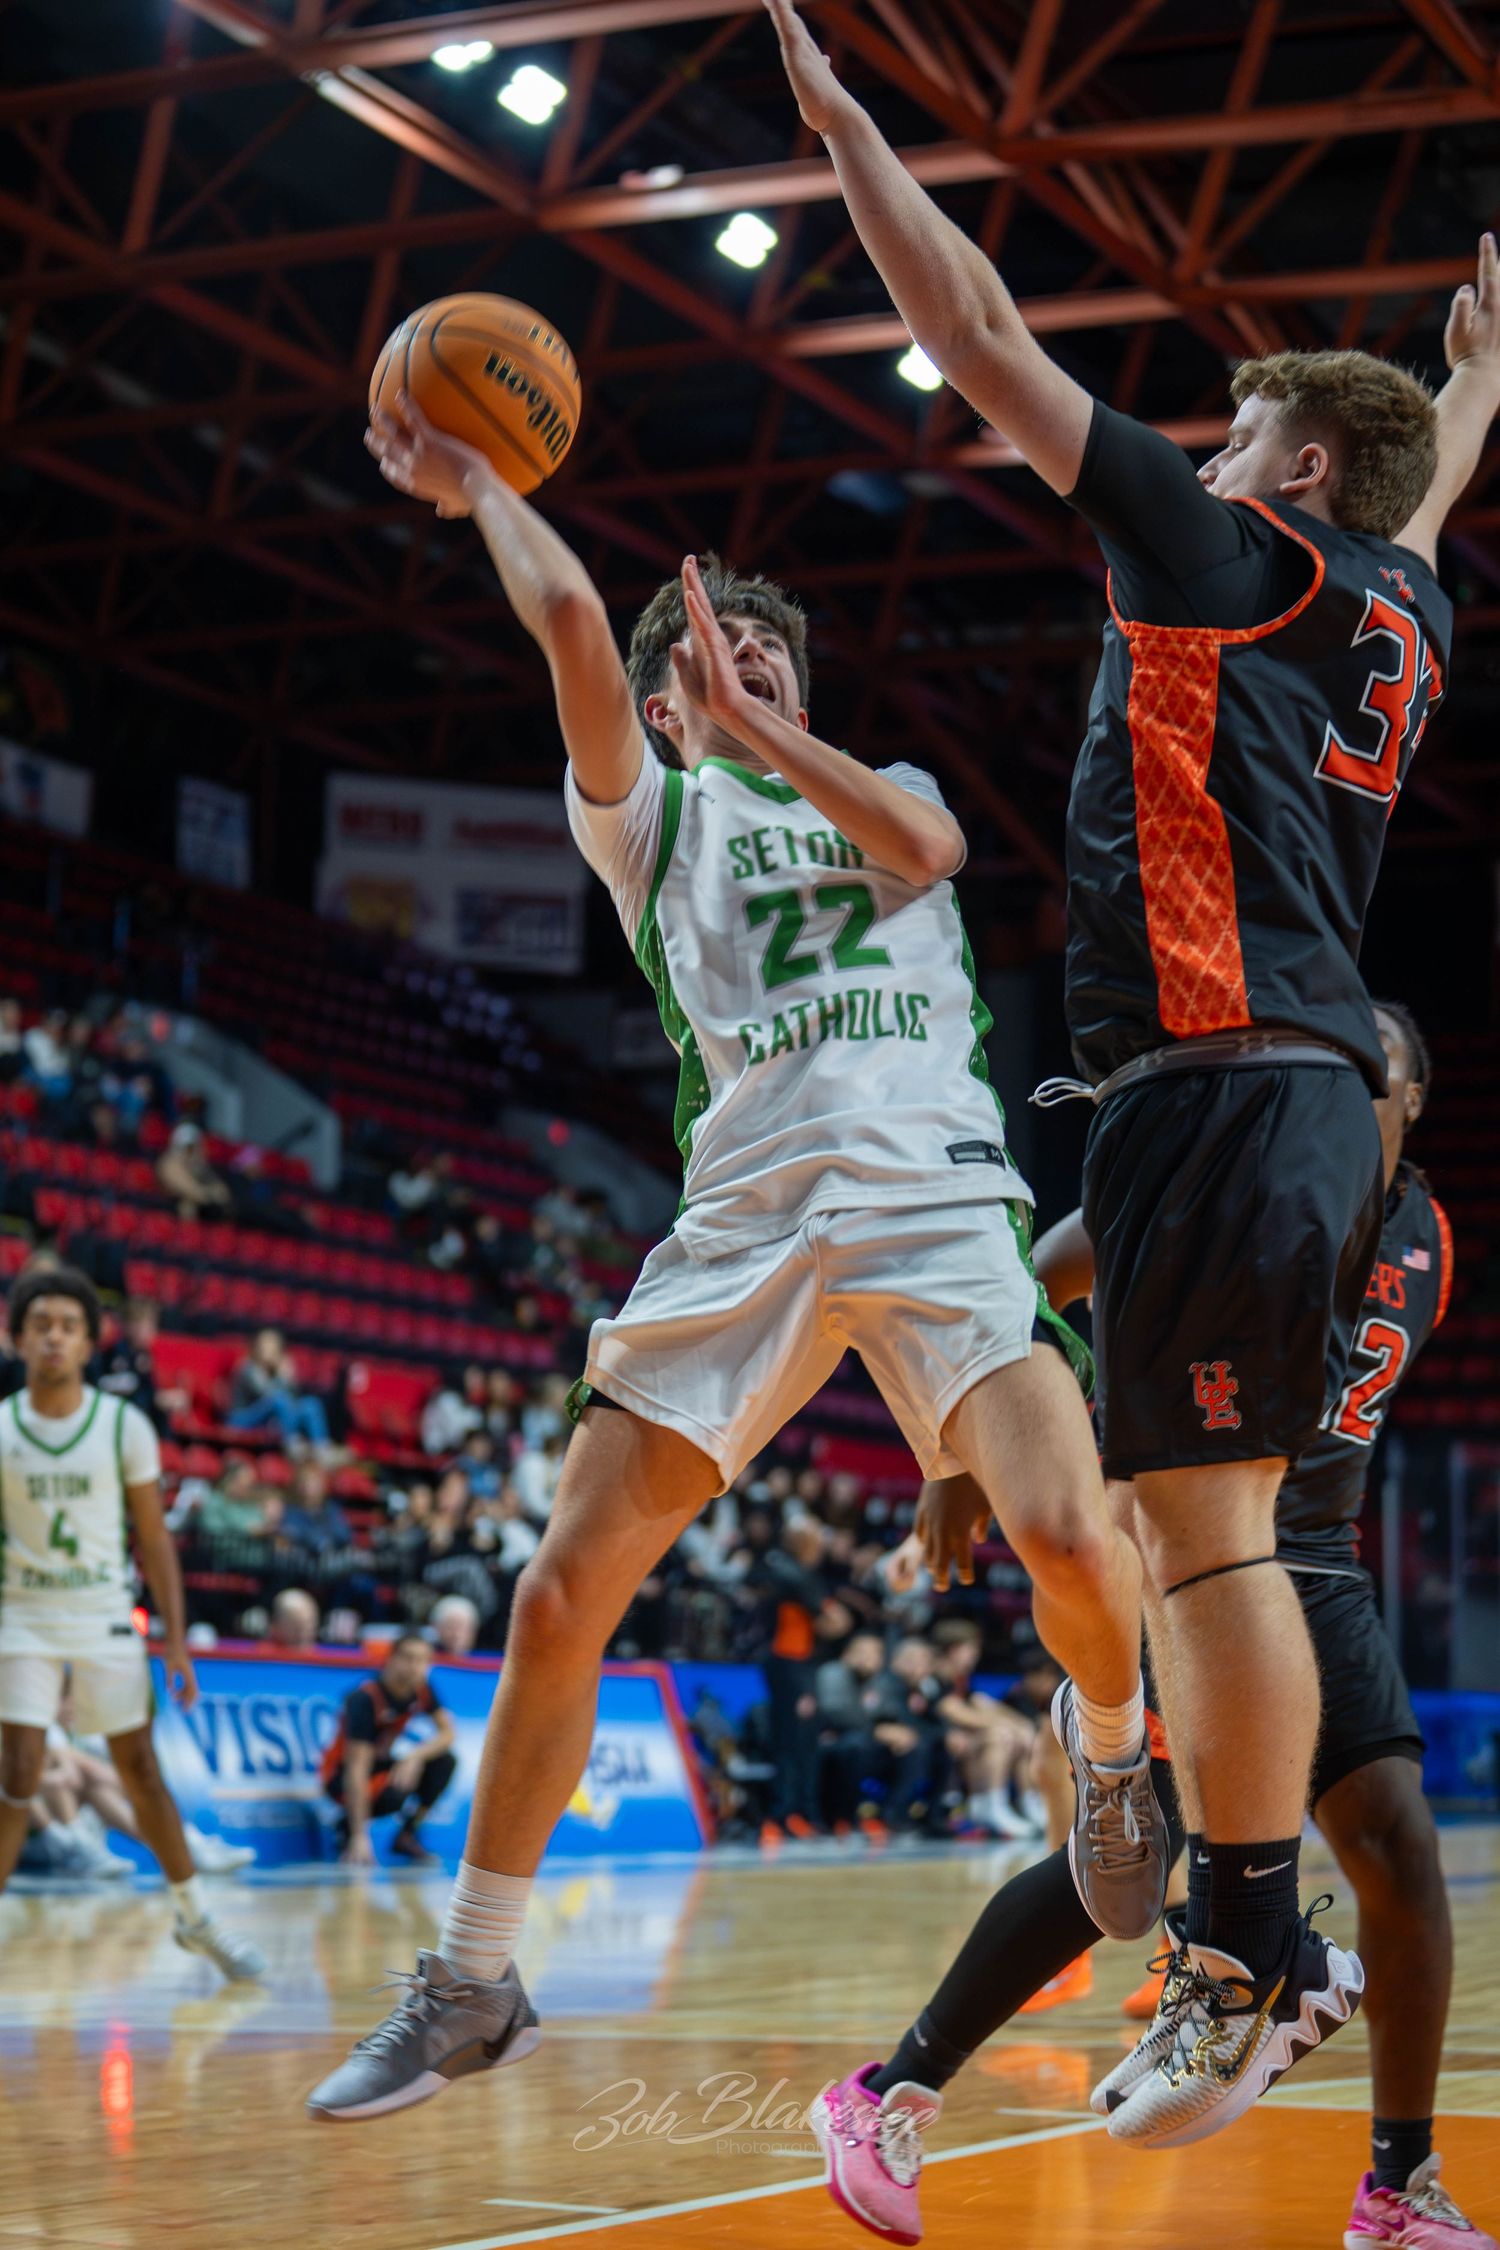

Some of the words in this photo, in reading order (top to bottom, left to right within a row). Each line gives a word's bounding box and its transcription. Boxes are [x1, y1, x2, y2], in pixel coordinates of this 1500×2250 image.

[484, 350, 572, 465] Wilson
[727, 826, 865, 880] SETON
[743, 879, 896, 994] 22
[738, 988, 931, 1067] CATHOLIC
[49, 1508, 79, 1558] 4
